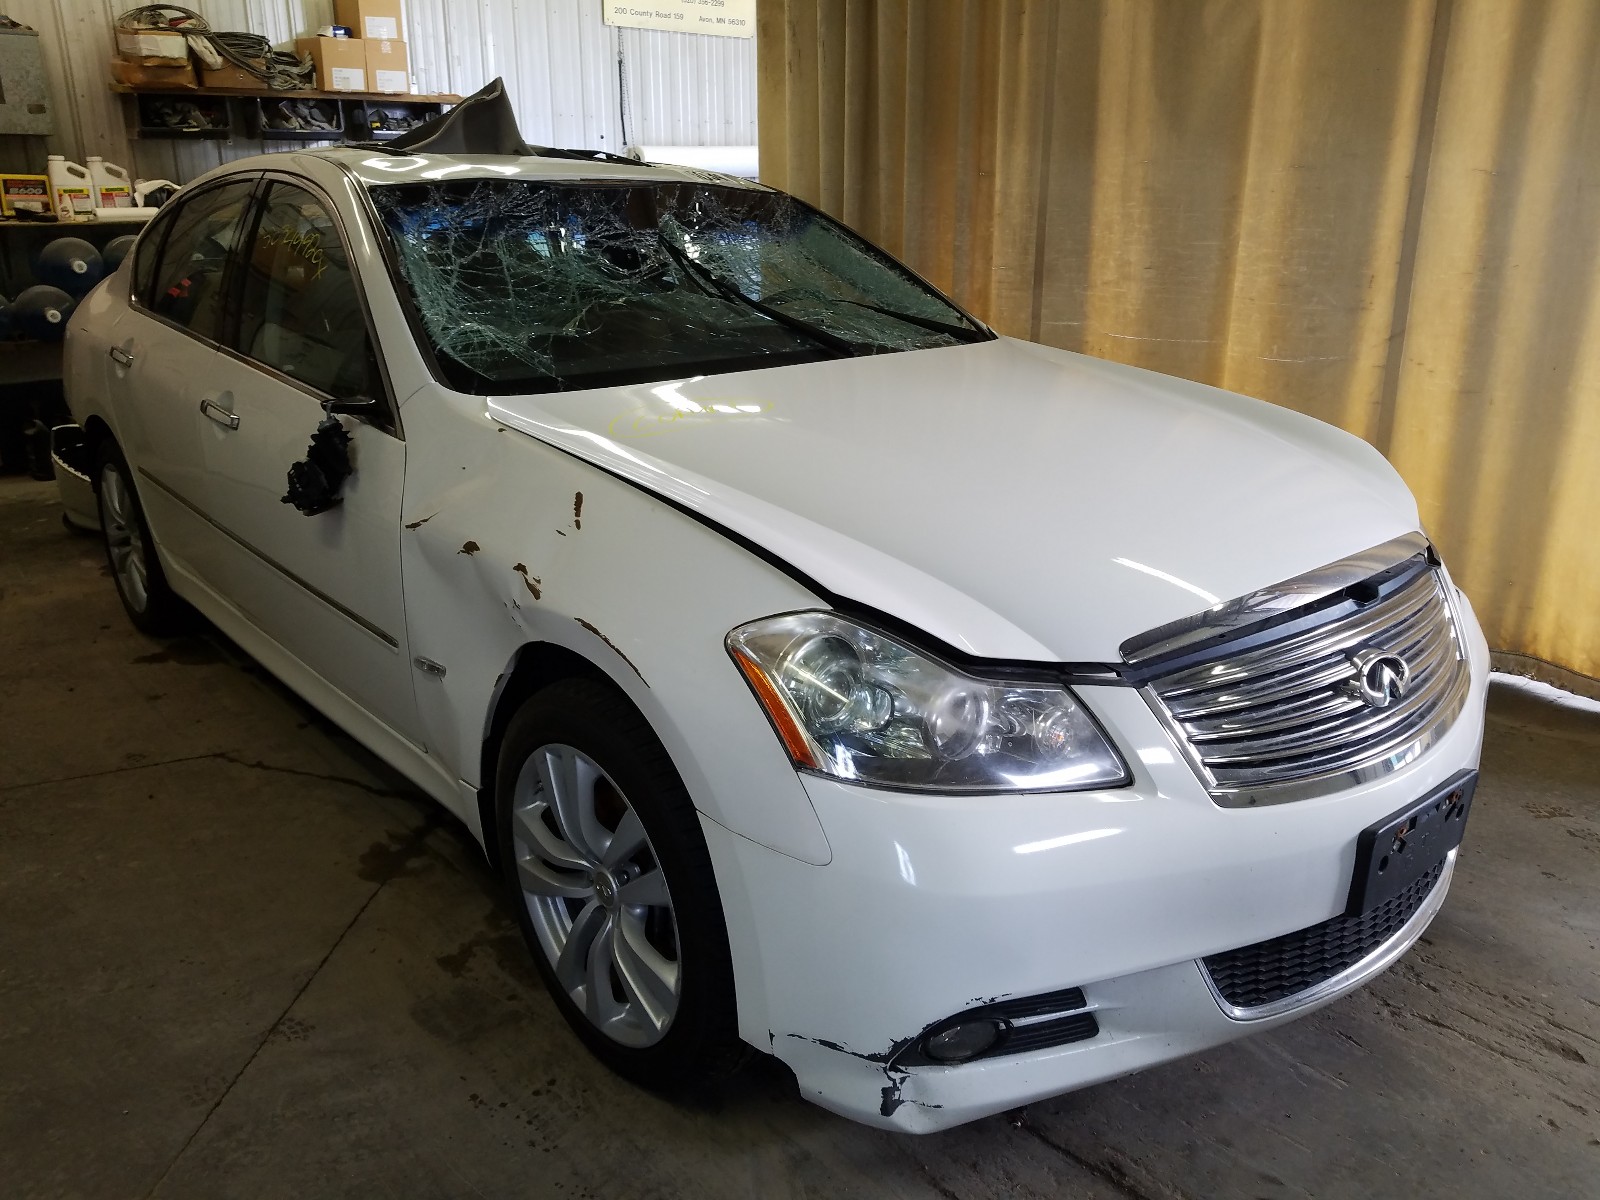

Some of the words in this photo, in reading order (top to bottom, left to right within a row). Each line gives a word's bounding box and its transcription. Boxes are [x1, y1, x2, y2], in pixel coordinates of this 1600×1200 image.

[630, 9, 652, 18] County
[655, 11, 671, 19] Road
[716, 17, 726, 25] MN
[728, 18, 746, 26] 56310
